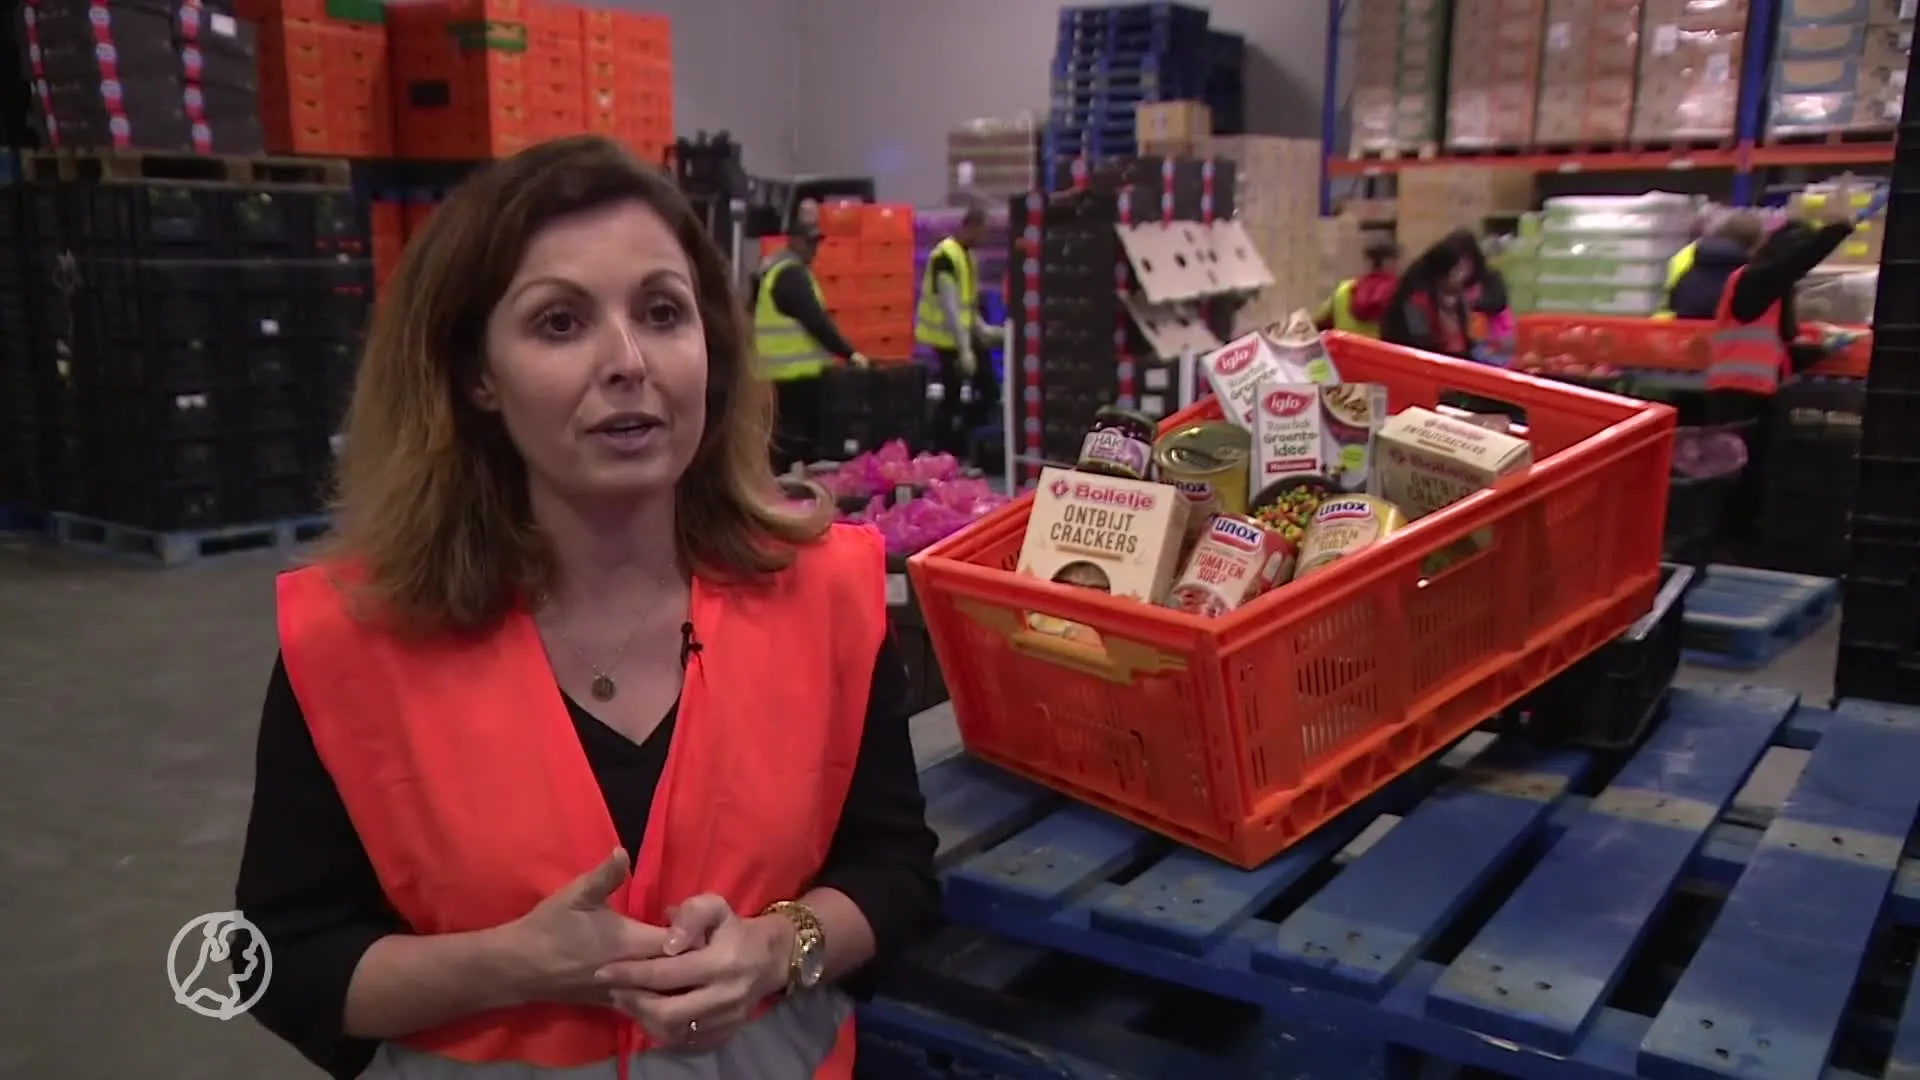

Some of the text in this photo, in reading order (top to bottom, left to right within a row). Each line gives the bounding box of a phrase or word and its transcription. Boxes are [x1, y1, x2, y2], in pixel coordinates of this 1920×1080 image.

[1075, 484, 1153, 511] Bolletje
[1063, 503, 1136, 533] ONTBIJT
[1050, 522, 1139, 554] CRACKERS
[1195, 552, 1246, 580] TOMATEN
